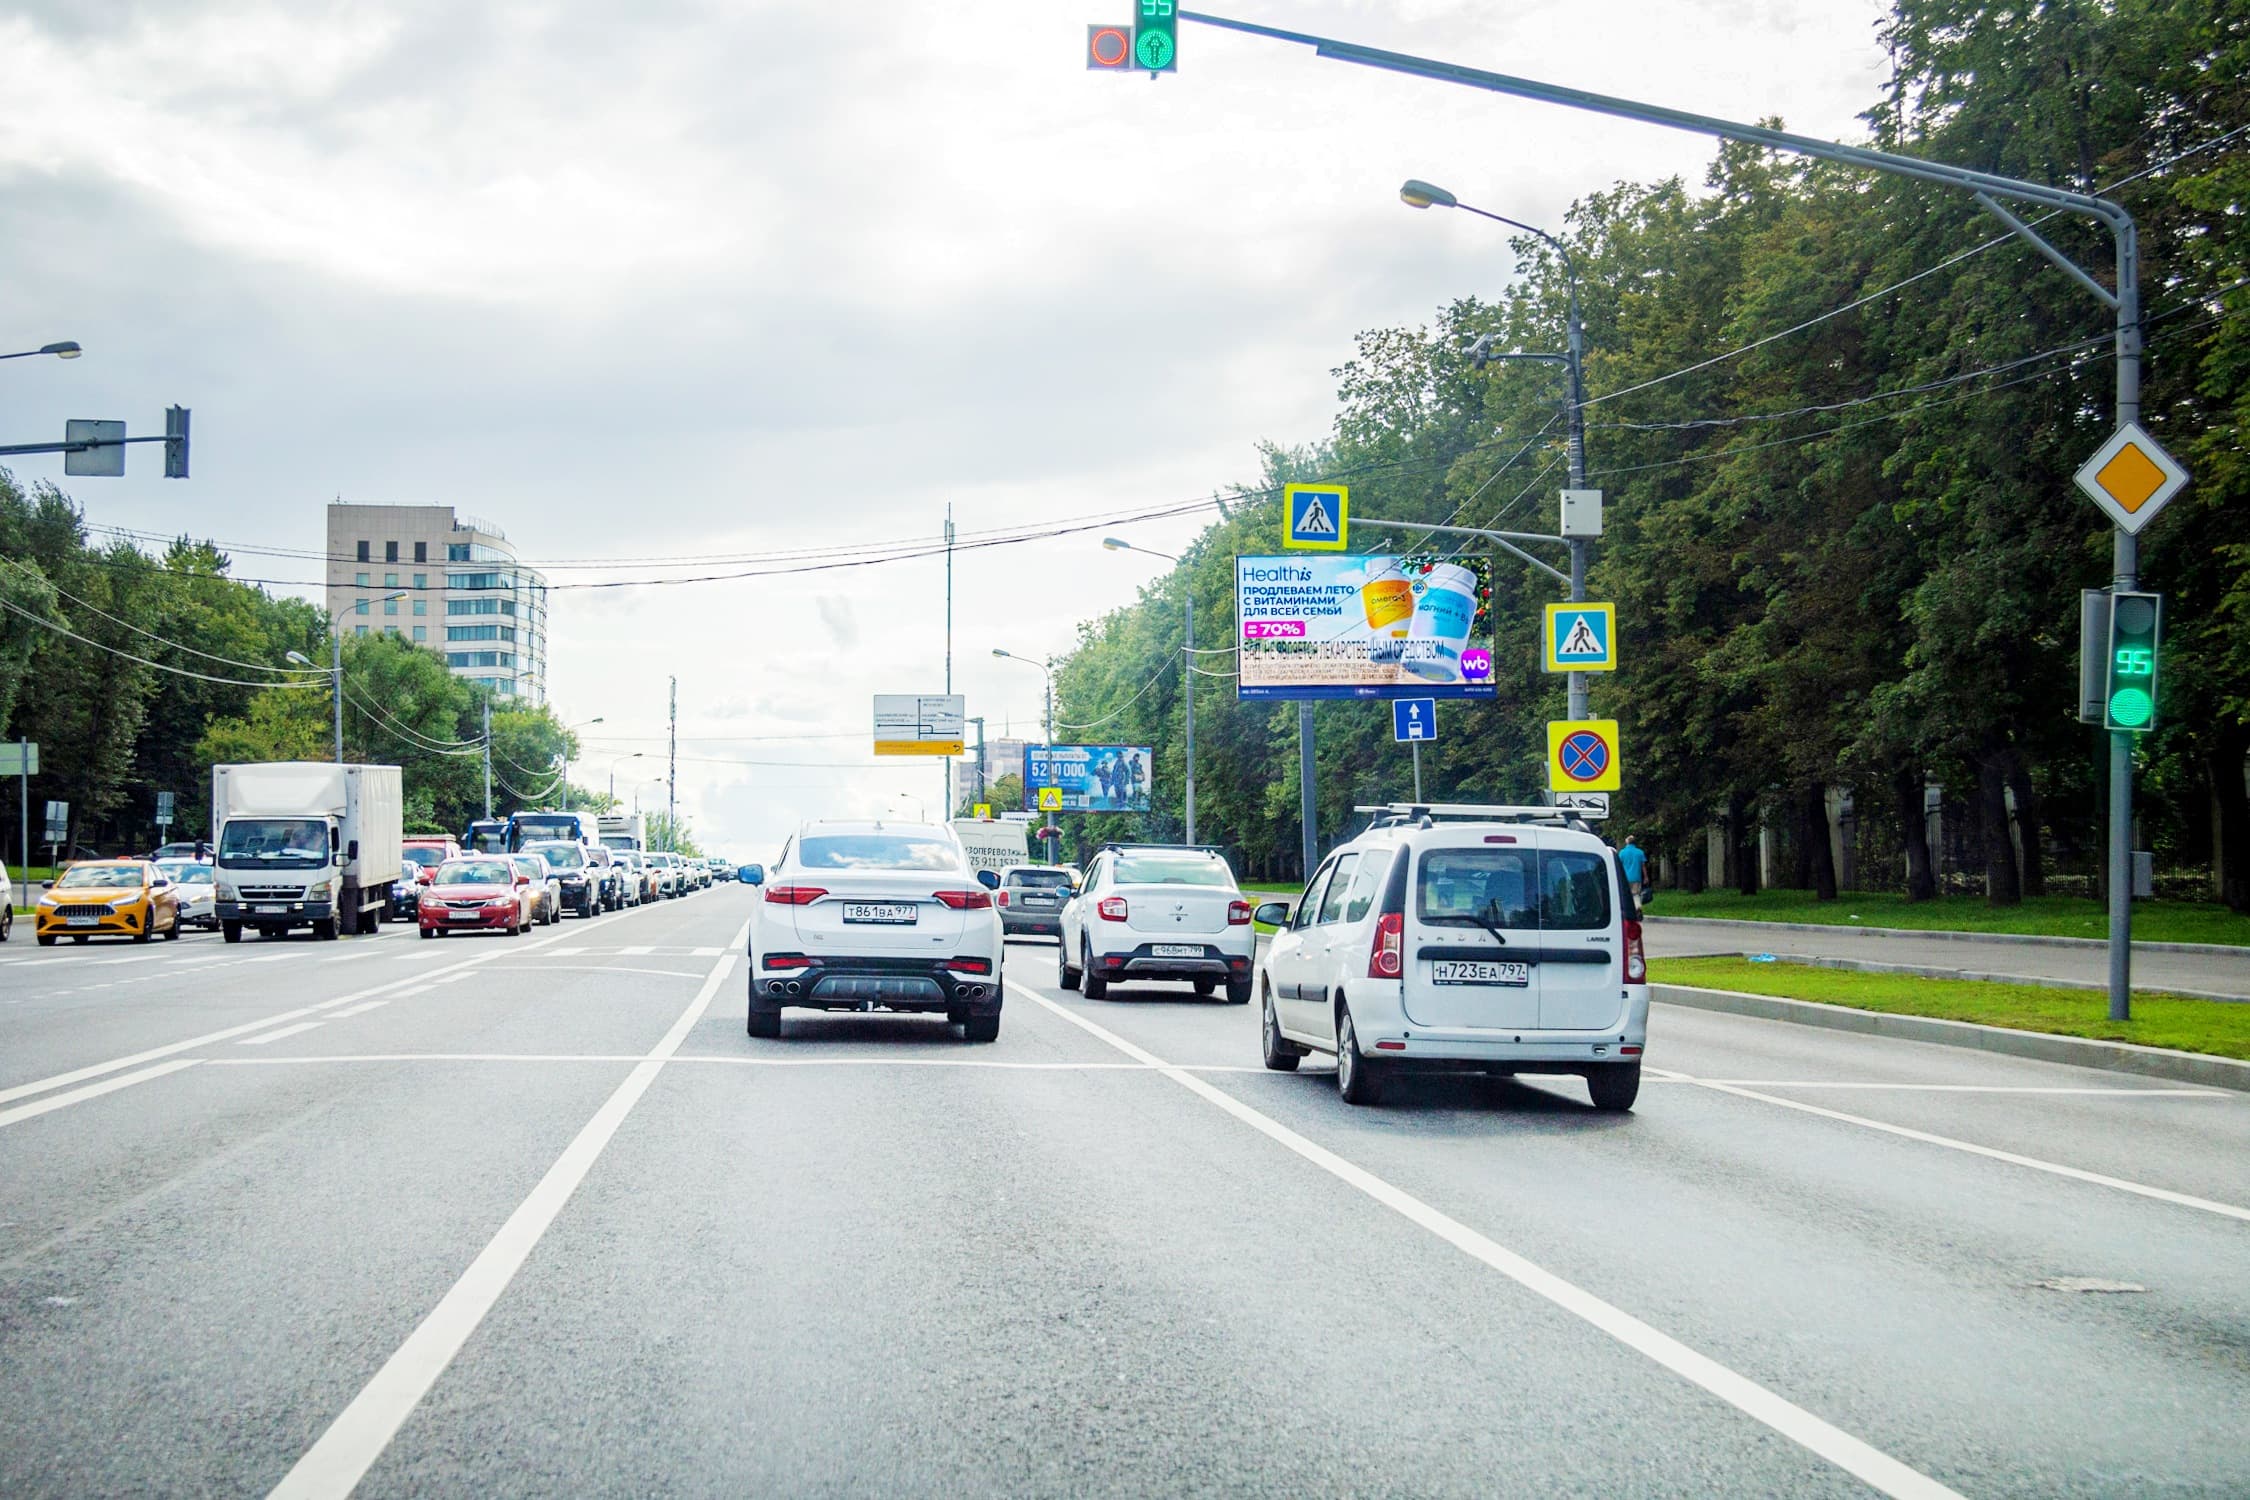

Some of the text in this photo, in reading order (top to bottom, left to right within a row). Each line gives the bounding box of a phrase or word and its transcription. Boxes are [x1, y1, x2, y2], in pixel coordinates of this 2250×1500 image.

[1142, 0, 1171, 16] 95
[1243, 566, 1312, 582] Healthis
[1243, 585, 1355, 596] ПРОДЛЕВАЕМ ЛЕТО
[1243, 596, 1336, 606] С ВИТАМИНАМИ
[1243, 606, 1342, 617] ДЛЯ ВСЕЙ СЕМЬИ
[1260, 624, 1301, 636] 70%
[1463, 656, 1488, 670] wb
[2117, 650, 2152, 674] 95
